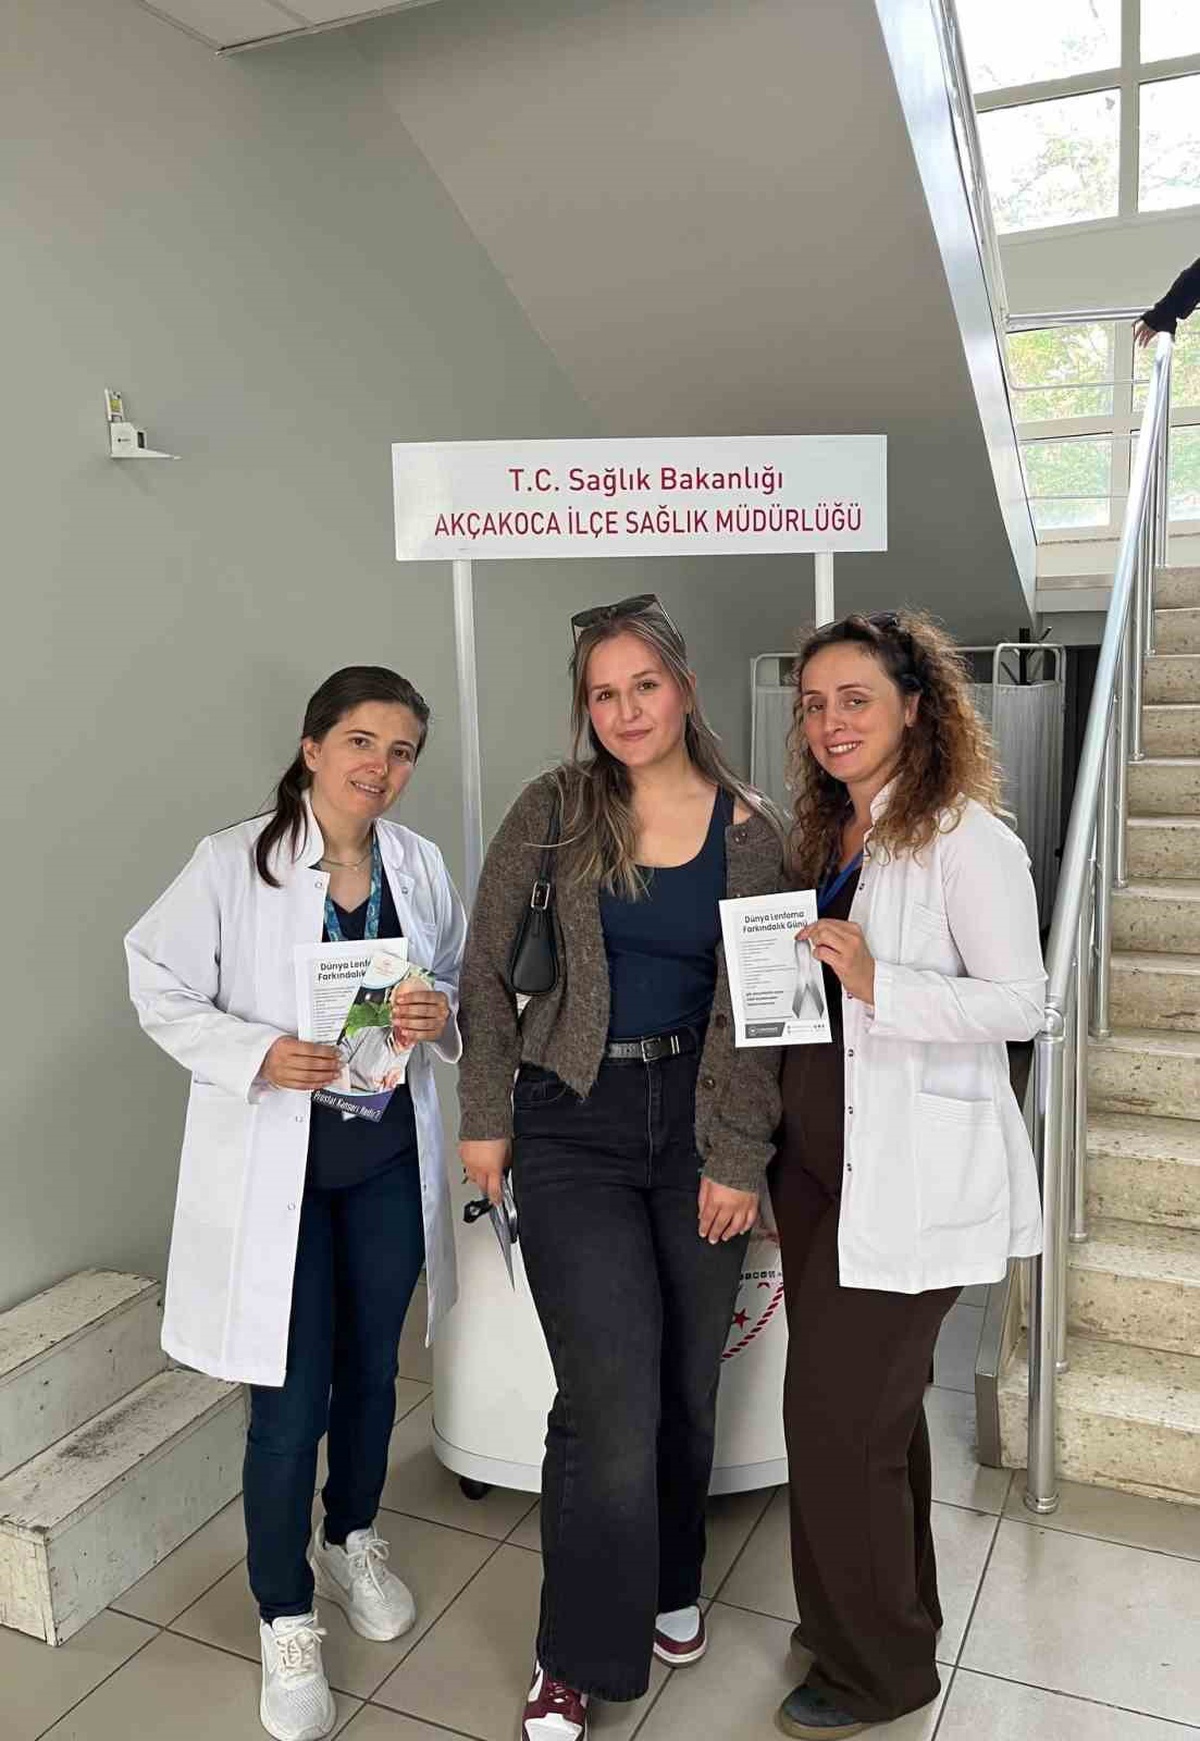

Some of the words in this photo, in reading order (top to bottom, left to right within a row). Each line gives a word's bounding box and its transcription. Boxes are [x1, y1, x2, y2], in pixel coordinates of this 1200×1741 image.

[508, 468, 560, 492] T.C.
[568, 466, 651, 497] Sağlık
[660, 465, 783, 495] Bakanlığı
[434, 511, 562, 540] AKÇAKOCA
[568, 505, 618, 538] İLÇE
[625, 504, 708, 534] SAĞLIK
[716, 501, 862, 533] MÜDÜRLÜĞÜ
[744, 914, 770, 924] Dünya
[770, 911, 805, 922] Lenfoma
[742, 922, 786, 933] Farkındalık
[320, 962, 349, 972] Dünya
